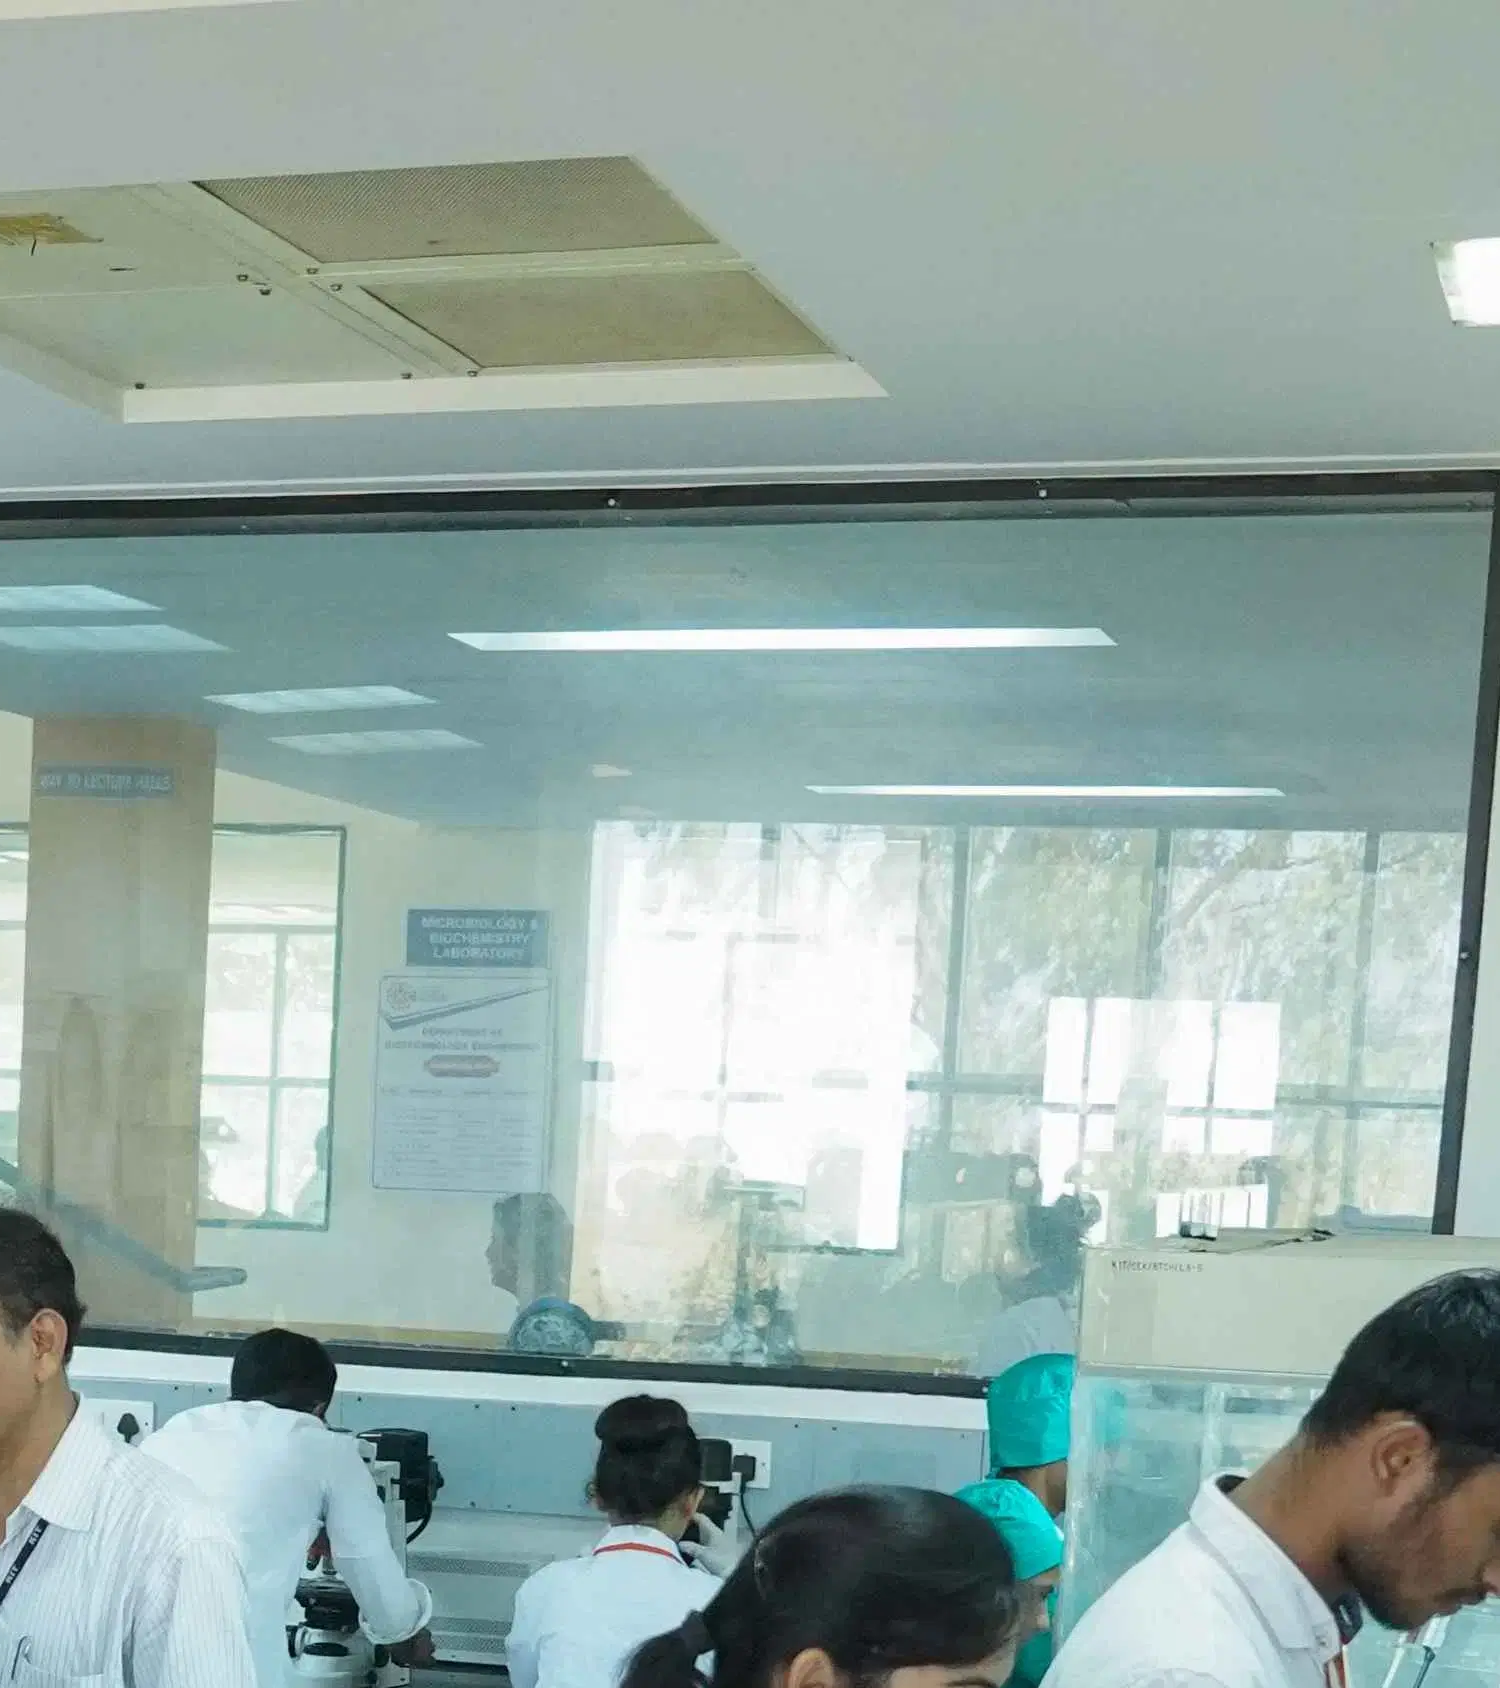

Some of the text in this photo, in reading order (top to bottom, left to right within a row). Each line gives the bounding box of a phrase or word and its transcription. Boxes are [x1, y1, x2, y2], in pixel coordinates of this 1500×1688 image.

[421, 916, 527, 930] MICROBIOLOGY
[429, 932, 531, 945] BIOCHEMISTRY
[432, 947, 525, 959] LABORATORY
[28, 1527, 42, 1546] KIT
[5, 1564, 19, 1584] KIT
